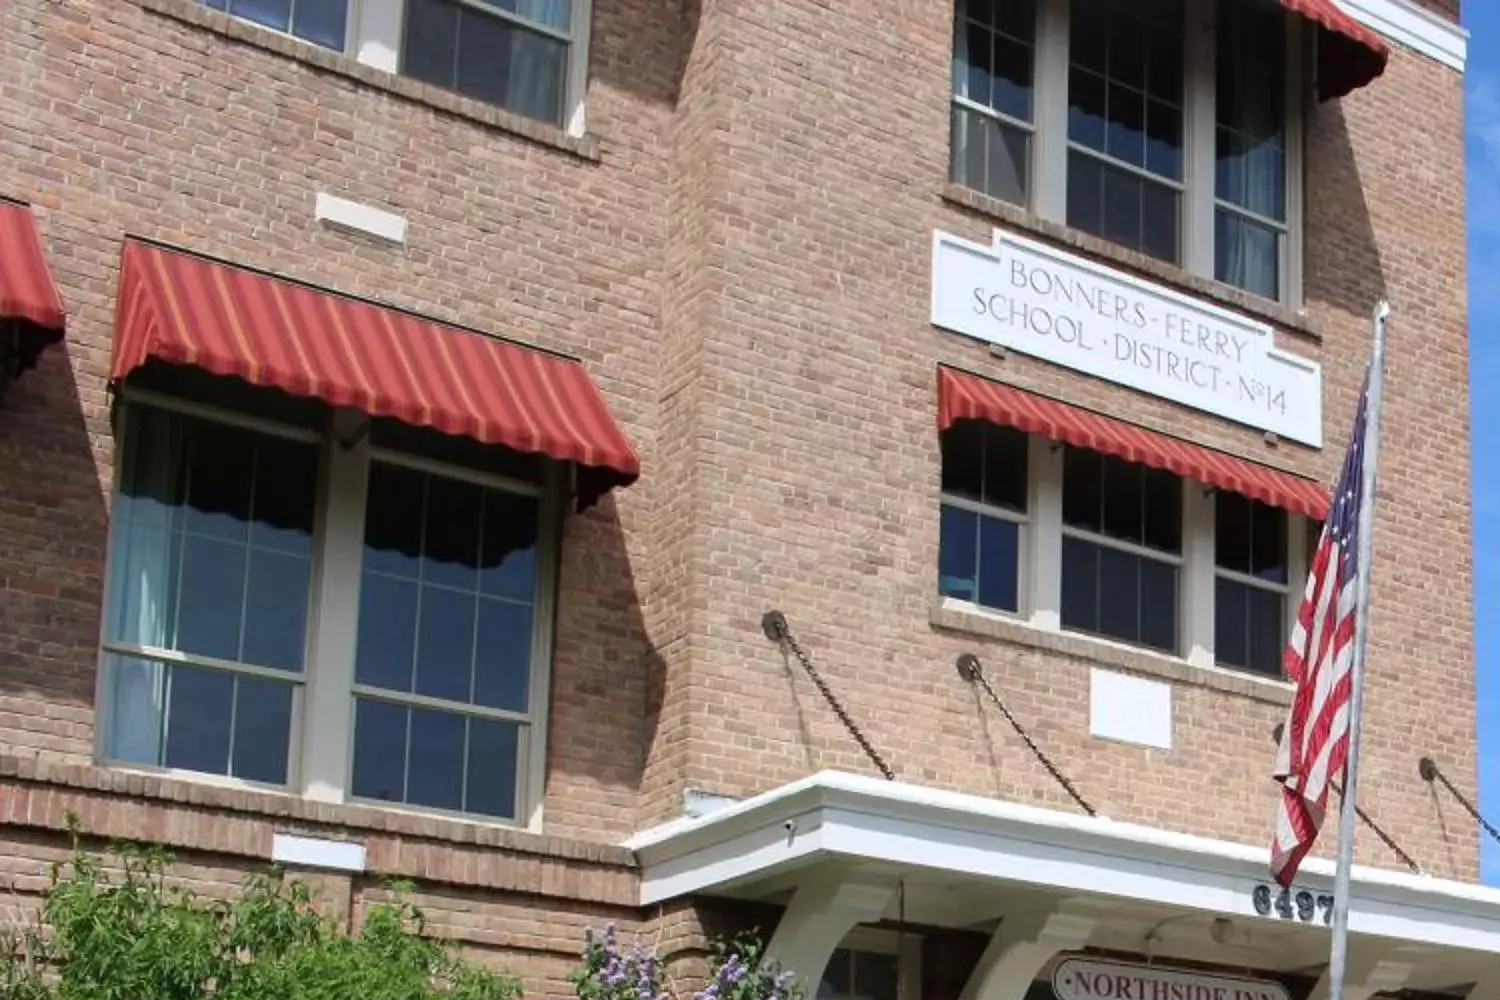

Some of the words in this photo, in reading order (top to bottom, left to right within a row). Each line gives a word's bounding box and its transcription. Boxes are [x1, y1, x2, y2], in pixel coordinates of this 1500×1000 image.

[973, 287, 1093, 351] SCHOOL
[1114, 332, 1221, 392] DISTRICT
[1252, 885, 1335, 924] 6497
